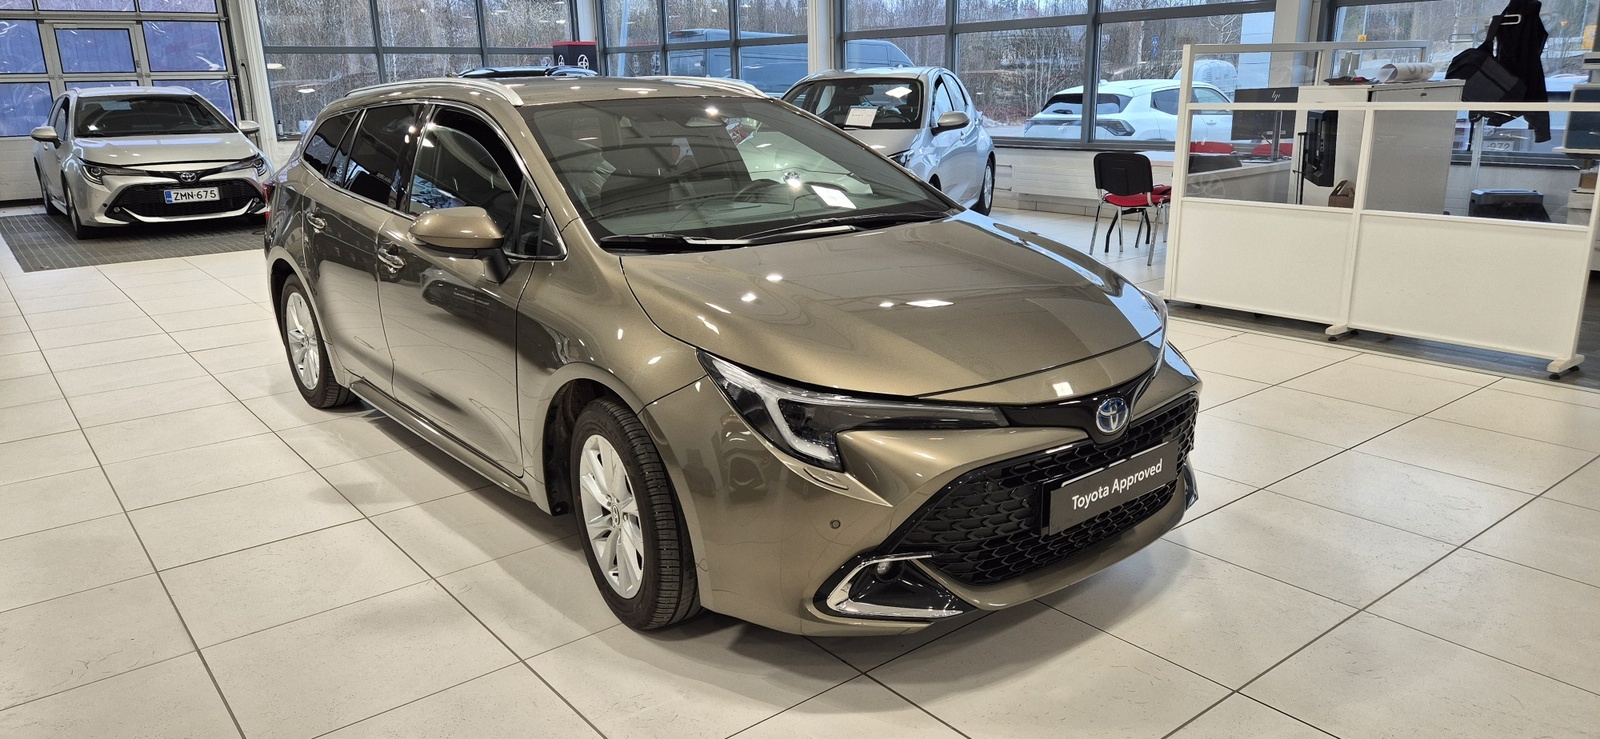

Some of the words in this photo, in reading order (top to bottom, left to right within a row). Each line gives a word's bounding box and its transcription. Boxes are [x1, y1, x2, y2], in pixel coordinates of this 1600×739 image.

[173, 189, 217, 201] ZMN-675
[1071, 486, 1110, 510] Toyota
[1111, 457, 1163, 494] Approved
